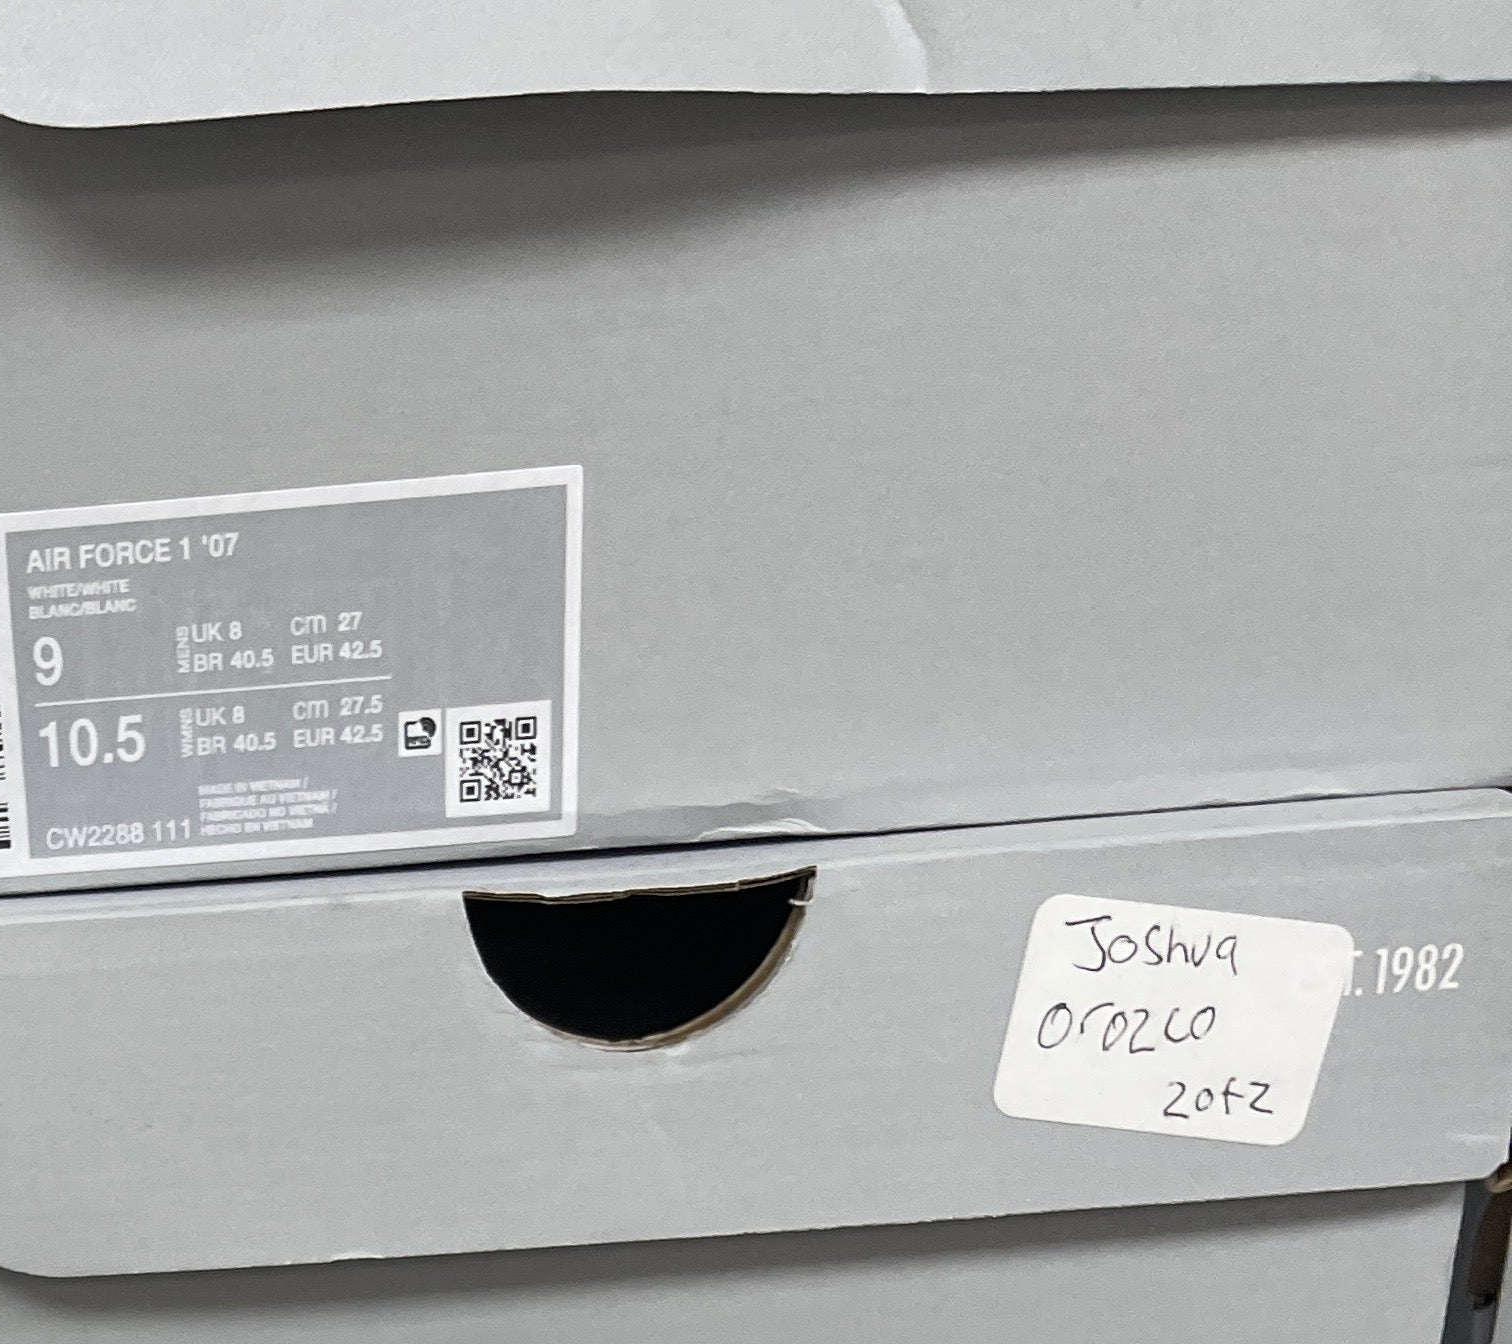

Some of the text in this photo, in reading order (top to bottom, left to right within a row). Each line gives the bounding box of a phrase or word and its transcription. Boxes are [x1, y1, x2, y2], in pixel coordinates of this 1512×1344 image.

[26, 532, 239, 574] AIR FORCE 1 '07
[26, 579, 131, 600] WHITE/WHITE
[28, 599, 138, 620] BLANC/BLANC
[338, 611, 363, 632] 27
[191, 621, 243, 643] UK 8
[33, 636, 63, 686] 9
[193, 648, 274, 673] BR 40.5
[291, 640, 383, 664] EUR 42.5
[195, 706, 245, 726] UK 8
[339, 695, 383, 716] 27.5
[39, 714, 146, 767] 10.5
[196, 732, 277, 756] BR 40.5
[293, 724, 384, 748] EUR 42.5
[46, 818, 191, 850] CW2288 111
